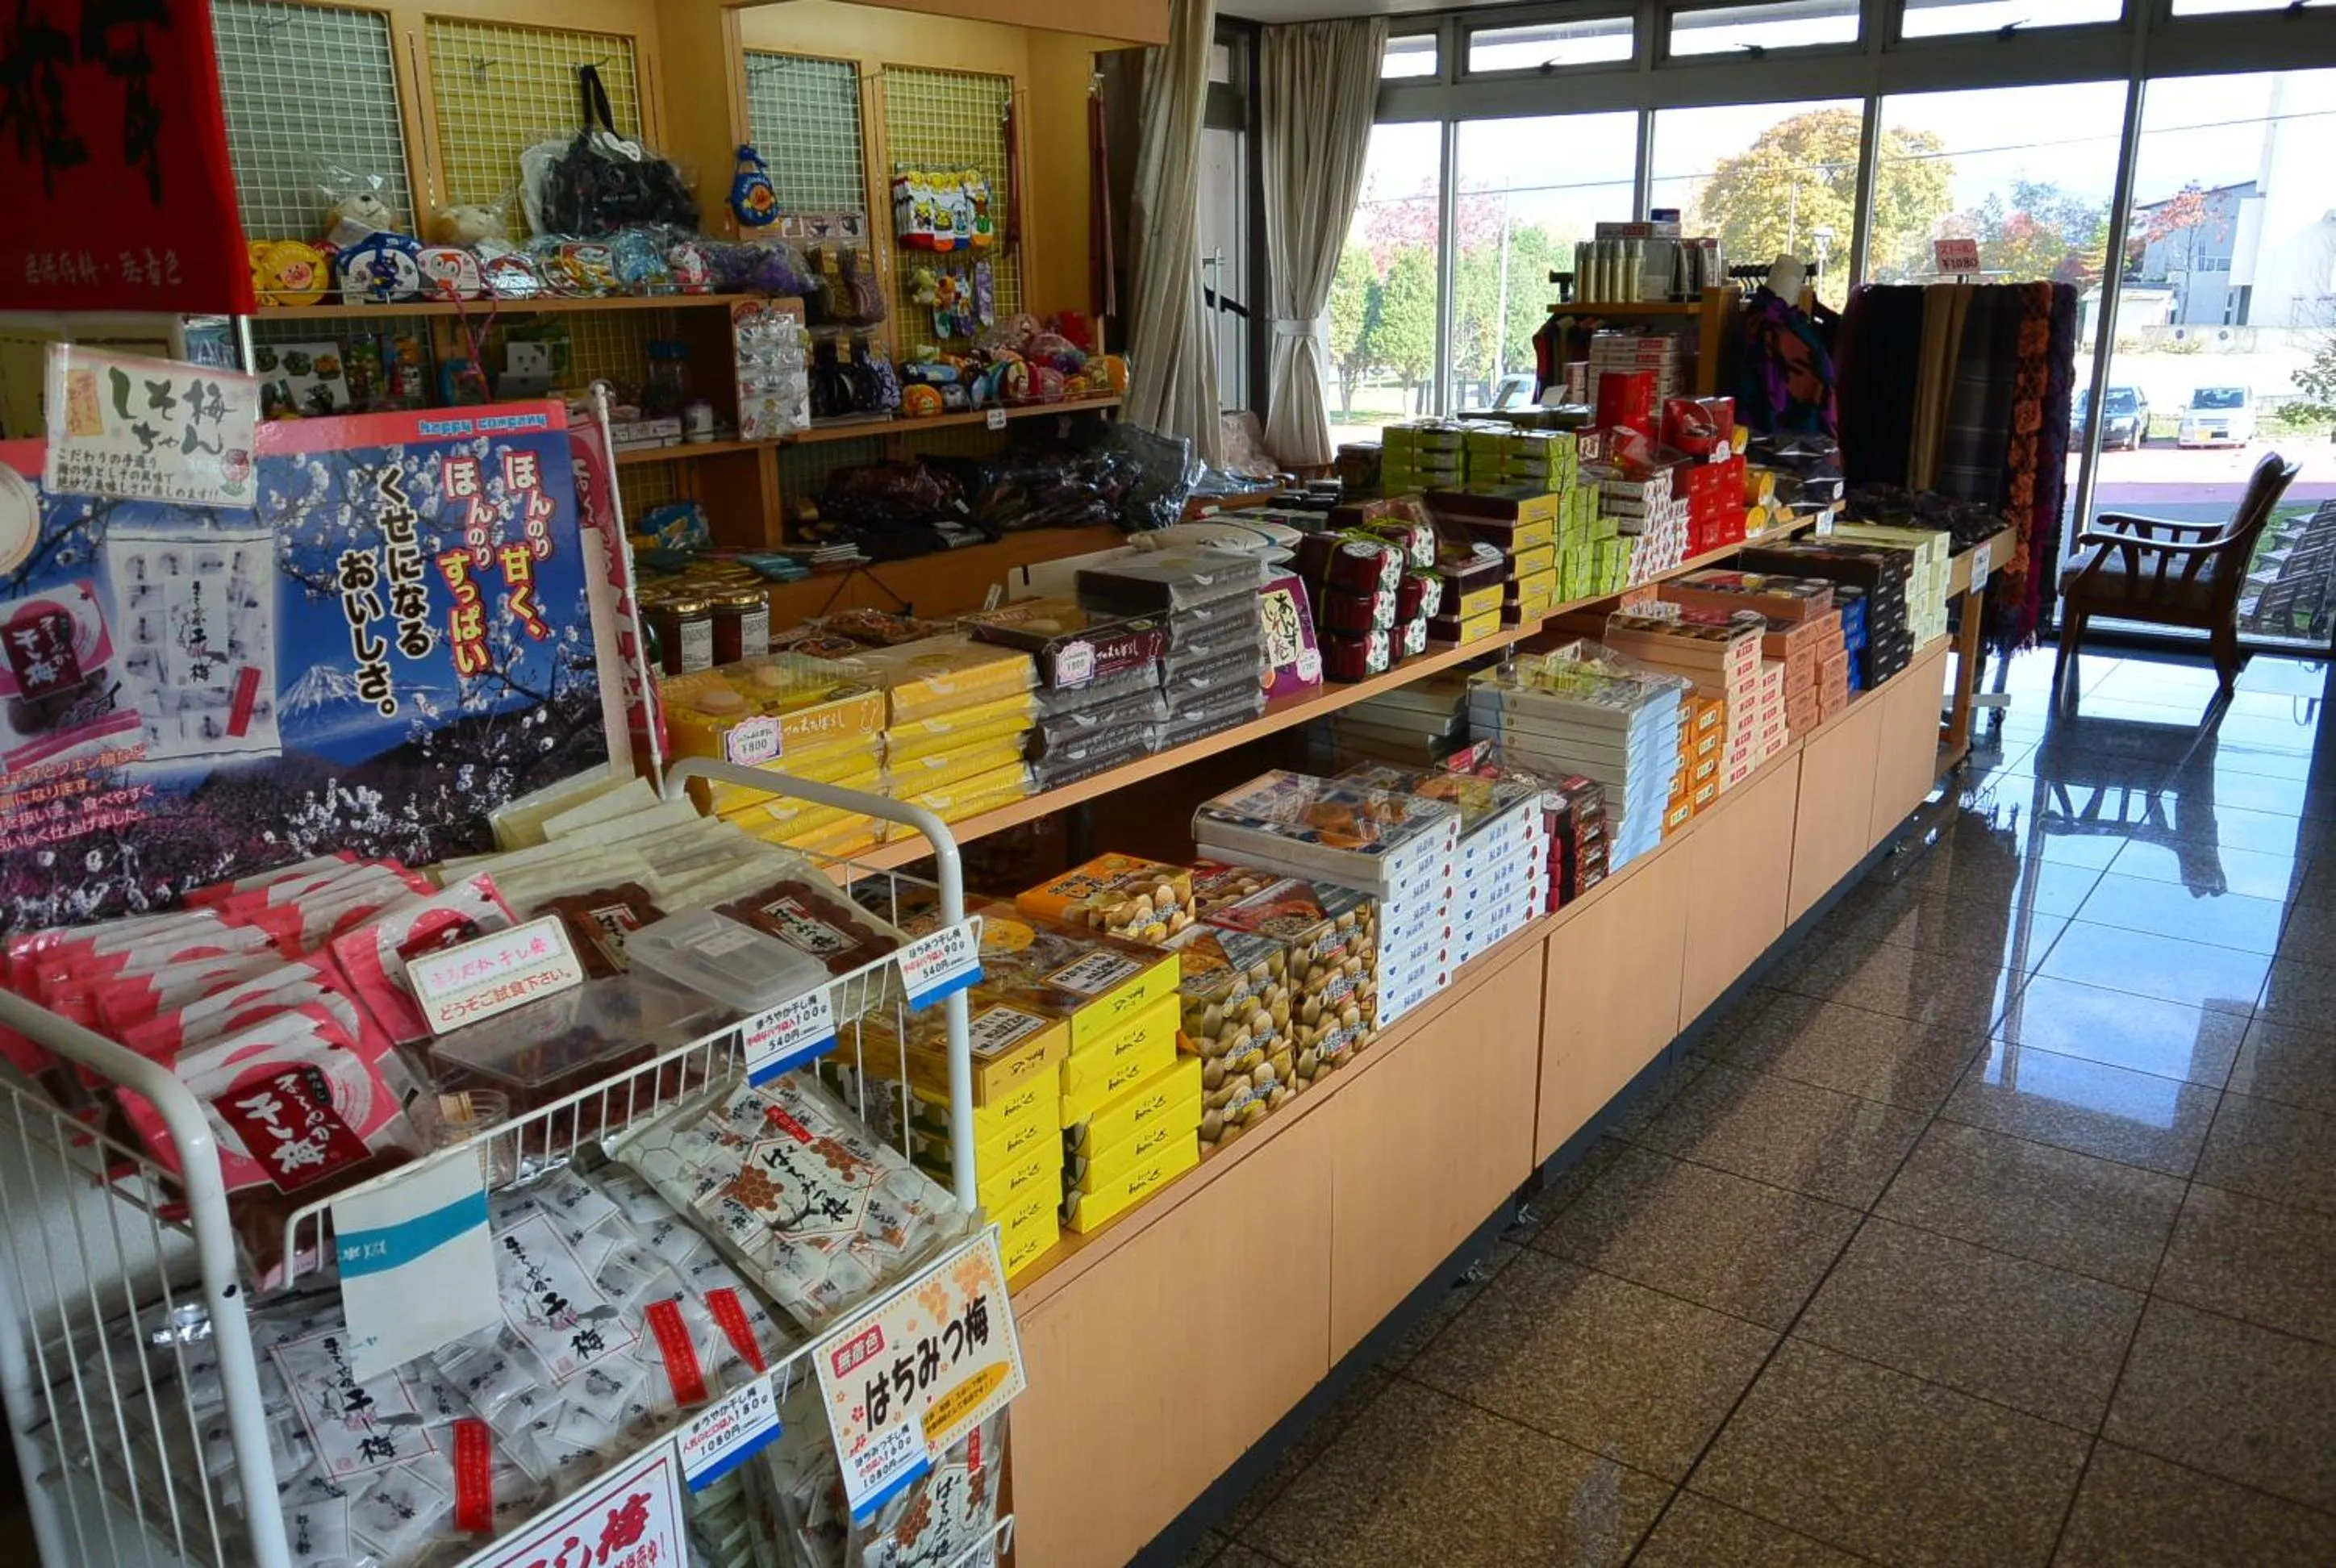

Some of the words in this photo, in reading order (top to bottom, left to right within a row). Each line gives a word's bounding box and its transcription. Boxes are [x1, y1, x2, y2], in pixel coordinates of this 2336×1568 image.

[109, 366, 237, 425] しそ梅
[419, 419, 472, 436] happy
[477, 414, 549, 429] company
[132, 421, 223, 454] ちゃん
[377, 466, 433, 658] くせになる
[437, 457, 497, 675] ほんのりすっぱい
[338, 550, 398, 719] おいしさ。
[769, 1028, 799, 1050] 540円
[866, 1295, 989, 1432] はちみつ梅
[701, 1424, 740, 1456] 1080円
